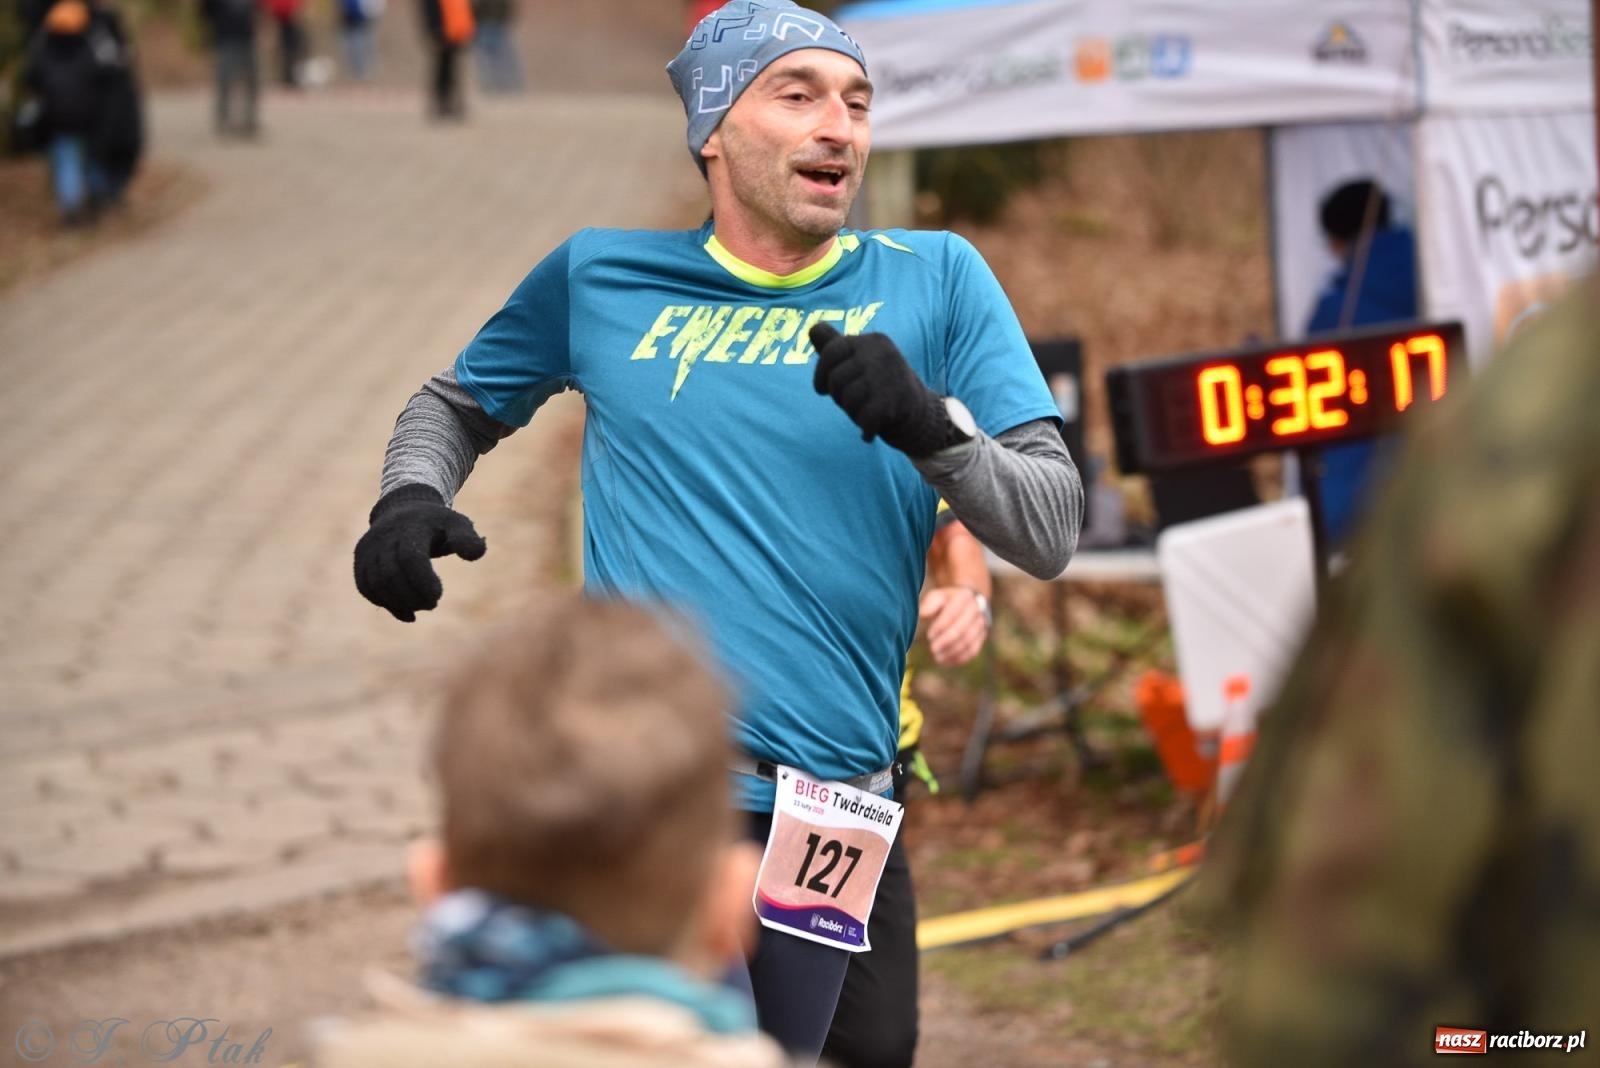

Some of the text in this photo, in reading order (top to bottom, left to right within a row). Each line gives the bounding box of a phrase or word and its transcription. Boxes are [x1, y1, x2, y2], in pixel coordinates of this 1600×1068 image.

[795, 779, 893, 826] BIEG Twardziela
[794, 832, 863, 898] 127
